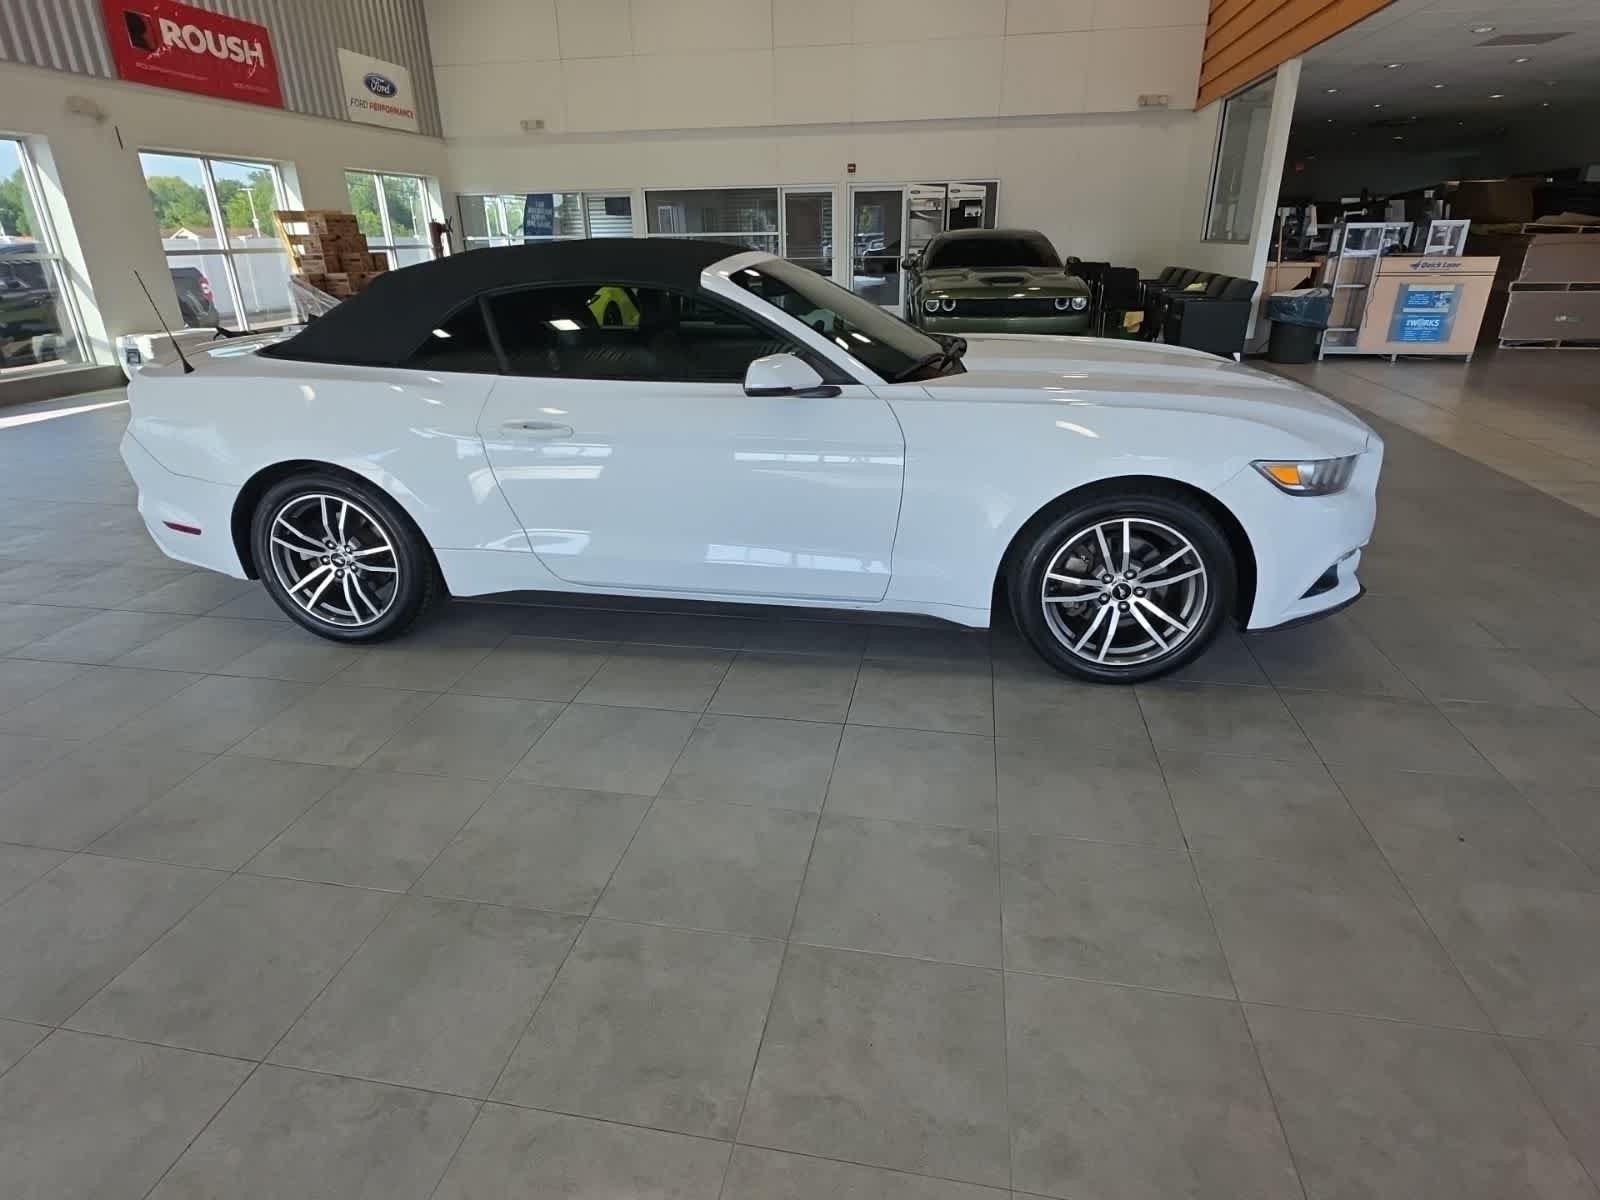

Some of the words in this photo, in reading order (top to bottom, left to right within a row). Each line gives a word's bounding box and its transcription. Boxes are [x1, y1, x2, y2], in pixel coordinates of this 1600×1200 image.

[158, 17, 265, 68] ROUSH
[370, 77, 391, 94] Ford
[350, 97, 369, 109] FORD
